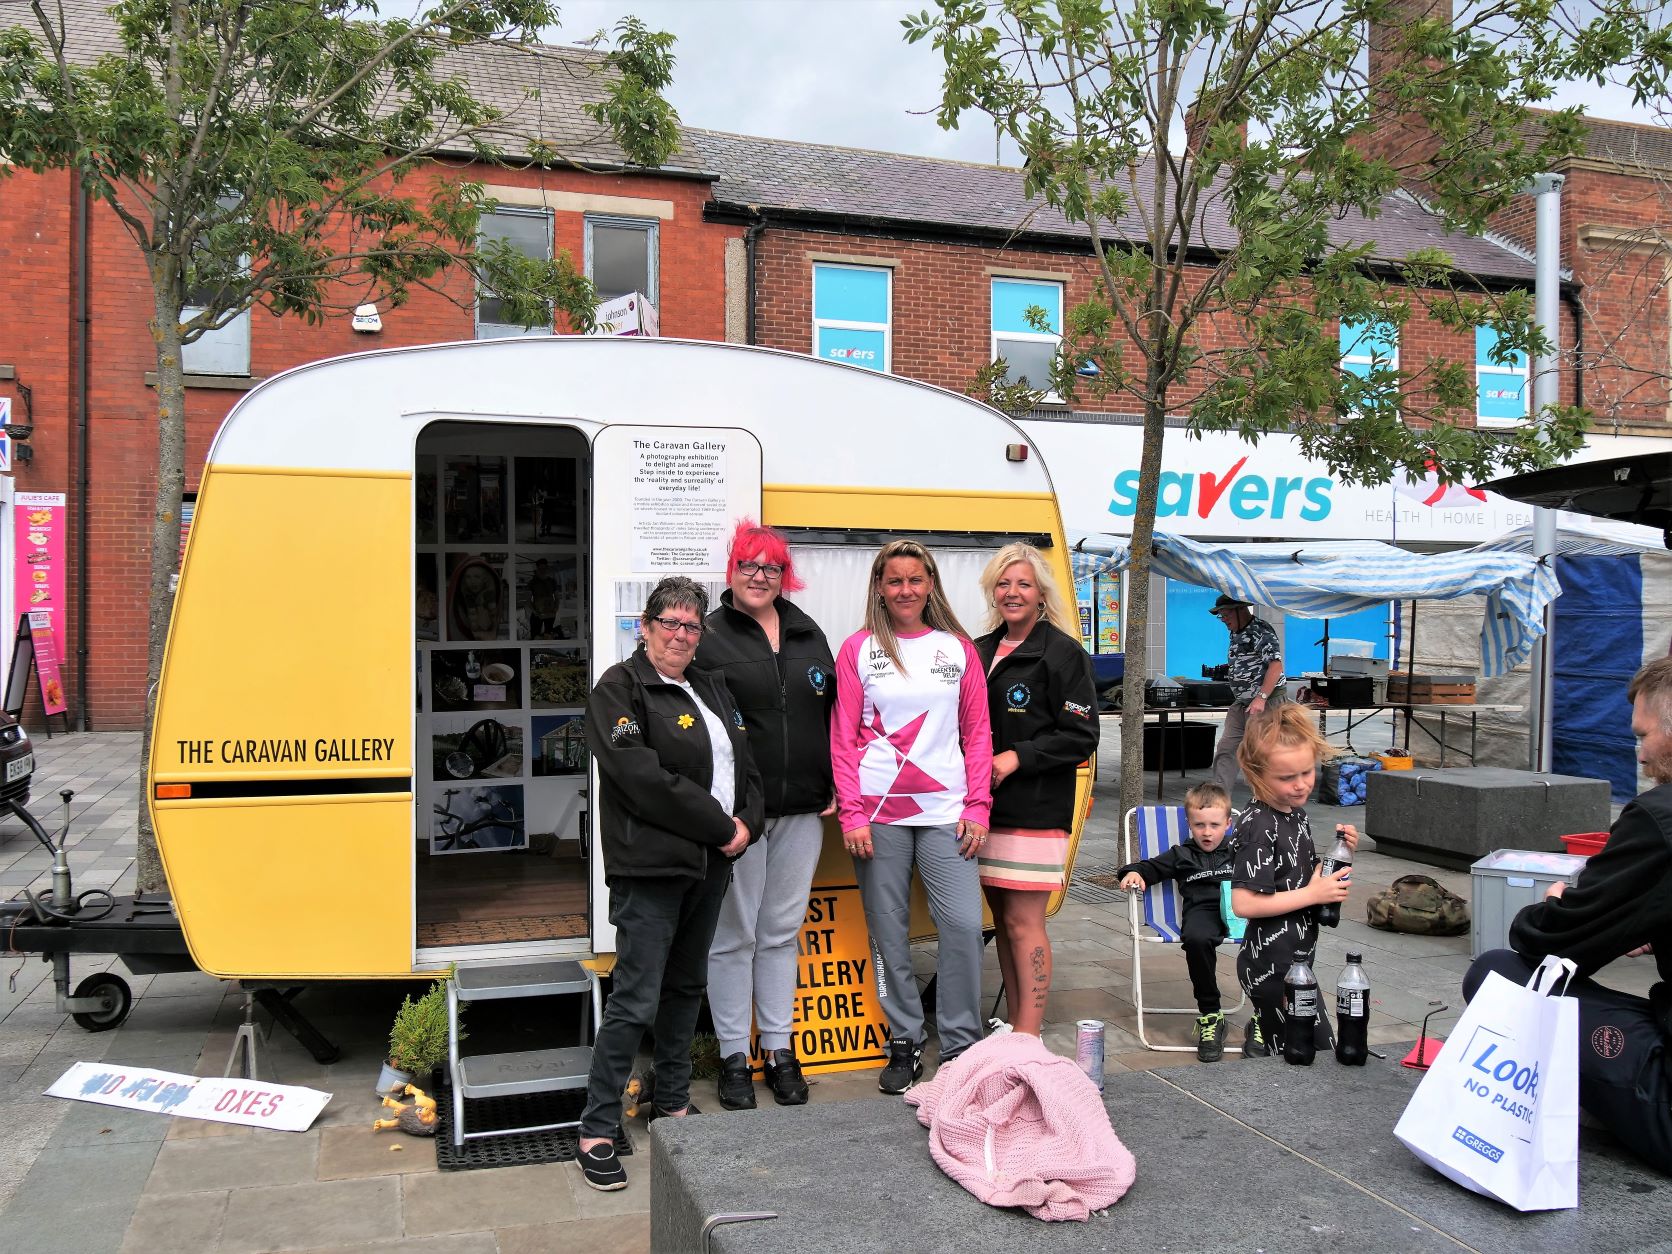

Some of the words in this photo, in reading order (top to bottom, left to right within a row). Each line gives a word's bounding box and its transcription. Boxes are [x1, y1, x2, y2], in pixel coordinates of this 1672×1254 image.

[829, 347, 875, 360] savers
[1485, 389, 1518, 399] savers
[633, 440, 651, 450] The
[653, 441, 690, 451] Caravan
[692, 441, 726, 452] Gallery
[646, 454, 686, 462] photography
[639, 469, 654, 477] Step
[653, 461, 676, 469] delight
[1107, 455, 1334, 522] savers
[1365, 509, 1420, 523] HEATH
[1443, 512, 1484, 525] HOME
[1506, 513, 1532, 526] BEA
[177, 740, 214, 764] THE
[221, 739, 307, 763] CARAVAN
[314, 738, 395, 762] GALLERY
[1186, 870, 1214, 882] UNDER
[803, 896, 838, 923] ST
[796, 958, 867, 989] LLERY
[876, 953, 888, 998] BIRMINGHAM
[793, 991, 865, 1023] EFORE
[214, 1088, 284, 1118] OXES
[1463, 1077, 1490, 1098] NO
[1491, 1093, 1534, 1124] PLASTIC
[1463, 1134, 1502, 1161] GREGGS
